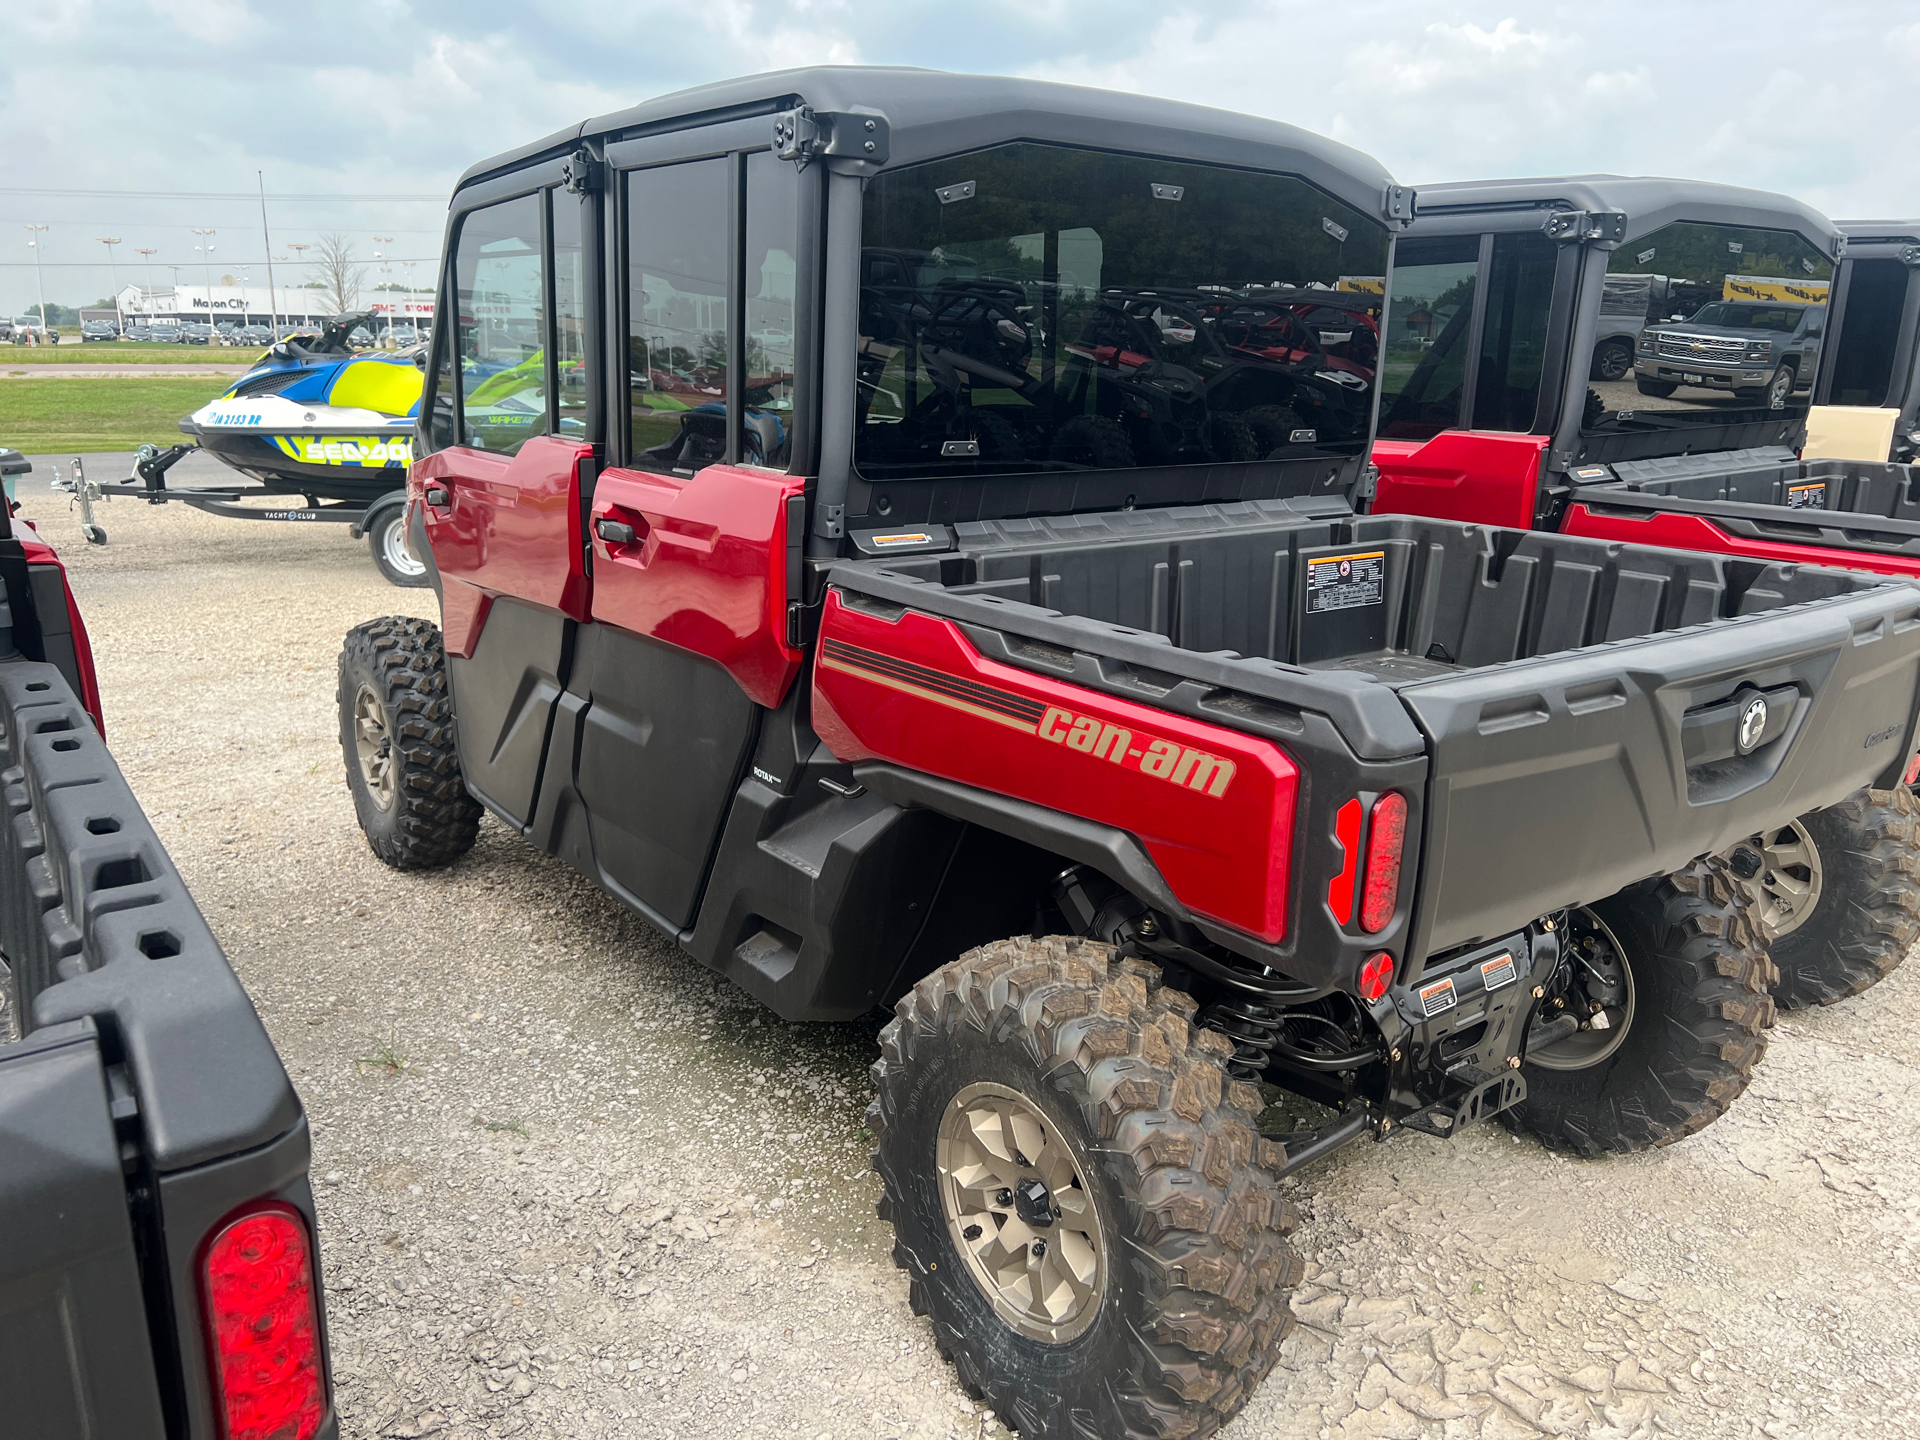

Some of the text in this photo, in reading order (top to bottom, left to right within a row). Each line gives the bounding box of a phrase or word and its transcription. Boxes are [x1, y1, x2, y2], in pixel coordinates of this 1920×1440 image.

[193, 298, 250, 312] Mason City
[371, 303, 396, 312] GMC
[224, 414, 247, 425] 2153
[488, 415, 523, 424] WAKE
[264, 511, 316, 520] YACHT CLUB
[1038, 706, 1235, 798] can-am
[753, 766, 773, 784] ROTAX
[1491, 958, 1507, 969] WARNING
[1430, 984, 1448, 995] WARNING
